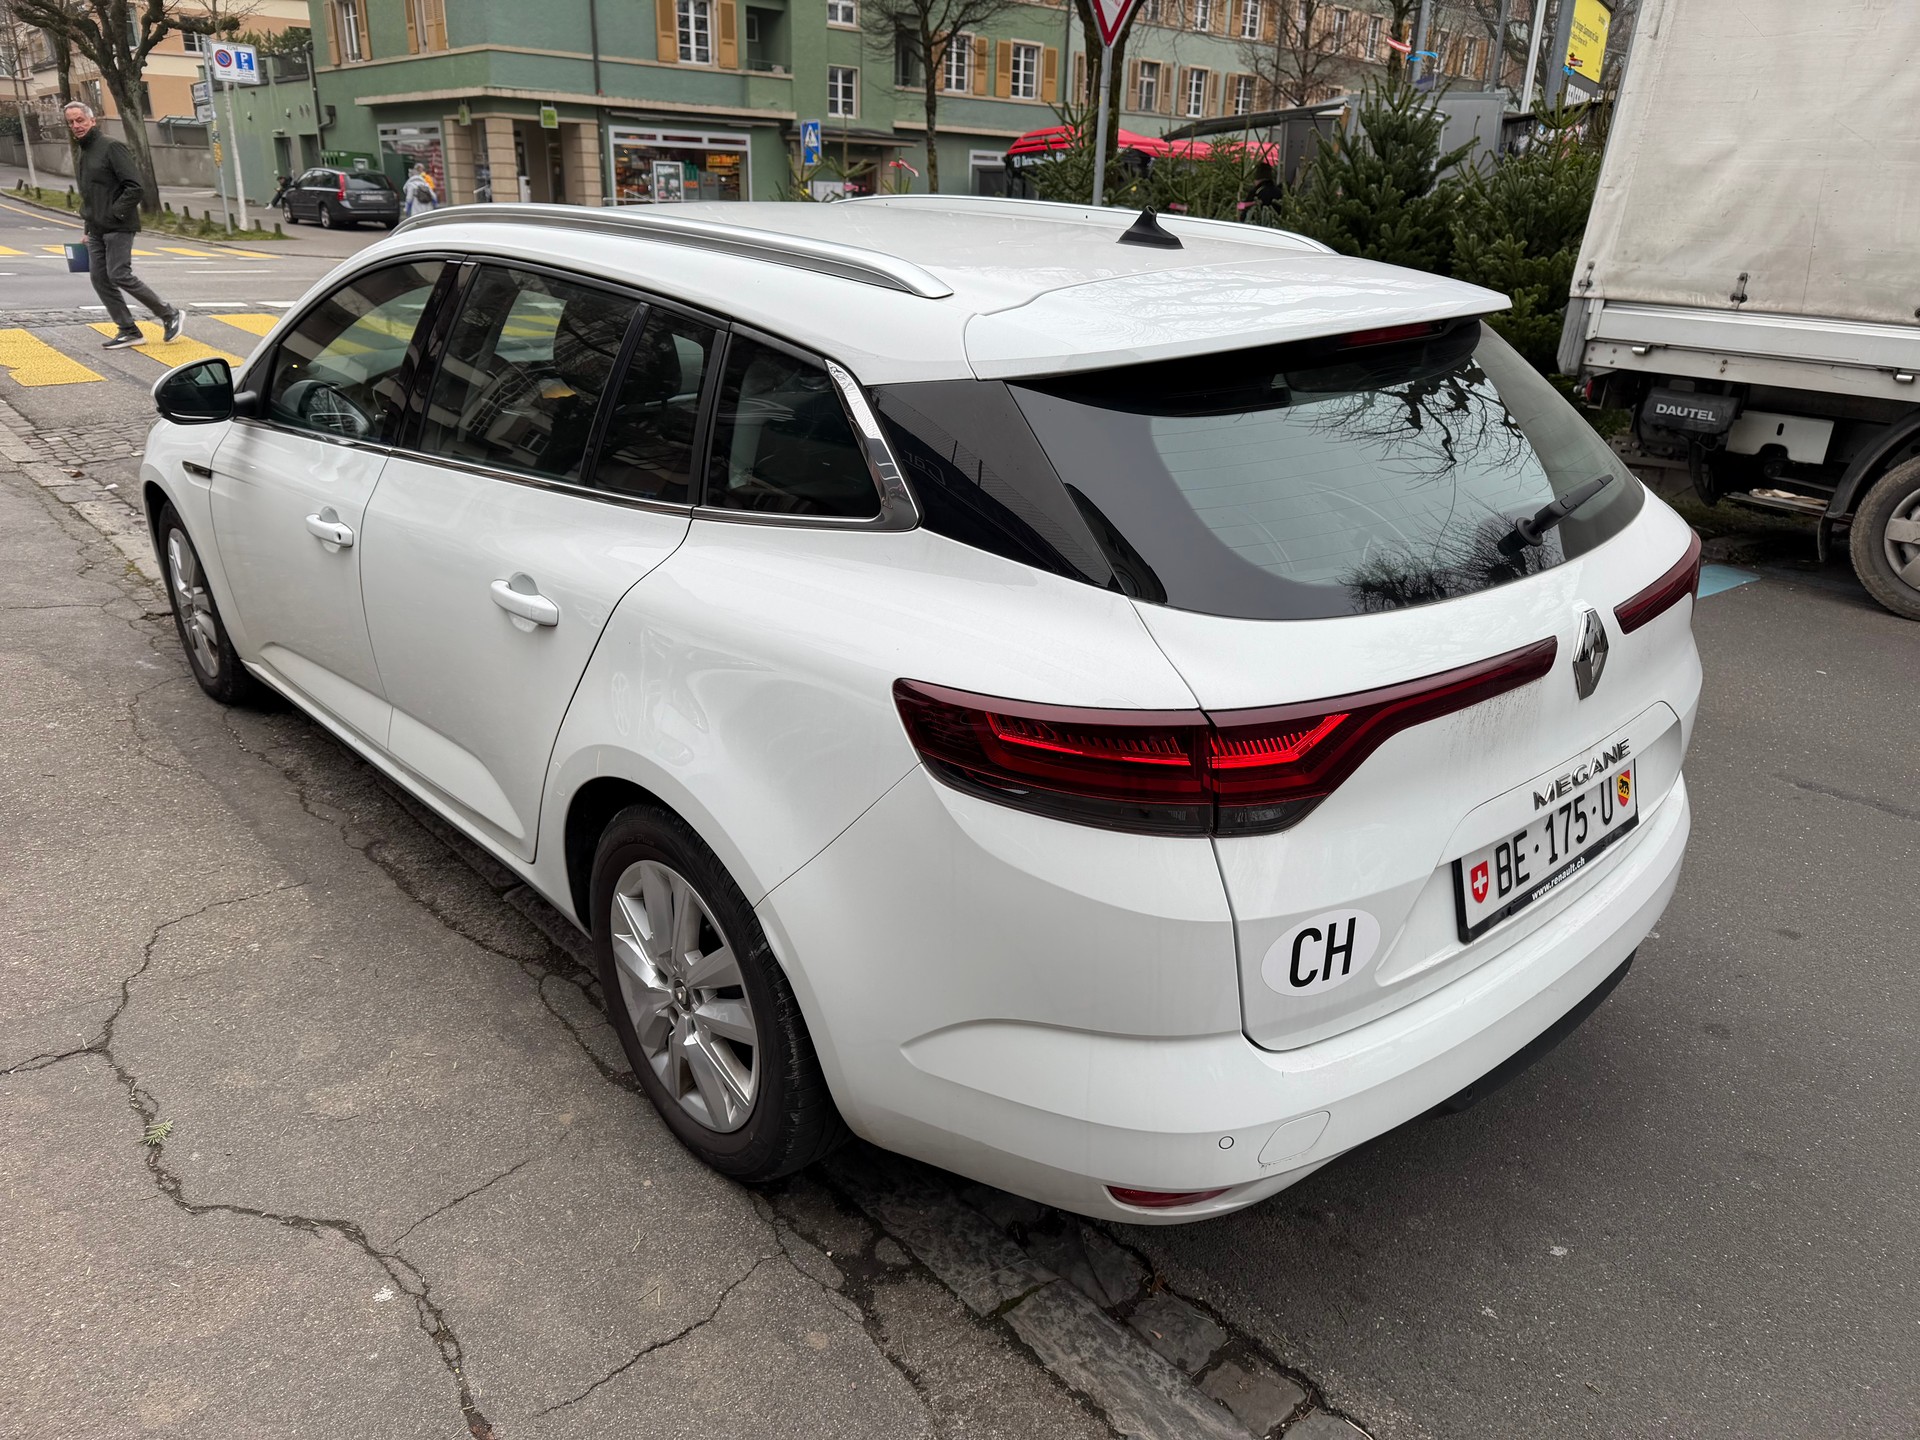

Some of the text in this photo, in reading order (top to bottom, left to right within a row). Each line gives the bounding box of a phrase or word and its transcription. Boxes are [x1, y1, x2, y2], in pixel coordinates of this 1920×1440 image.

[1655, 403, 1716, 421] DAUTEL
[1533, 737, 1631, 811] MEGANE
[1531, 857, 1586, 900] www.renault.ch
[1288, 916, 1357, 988] CH
